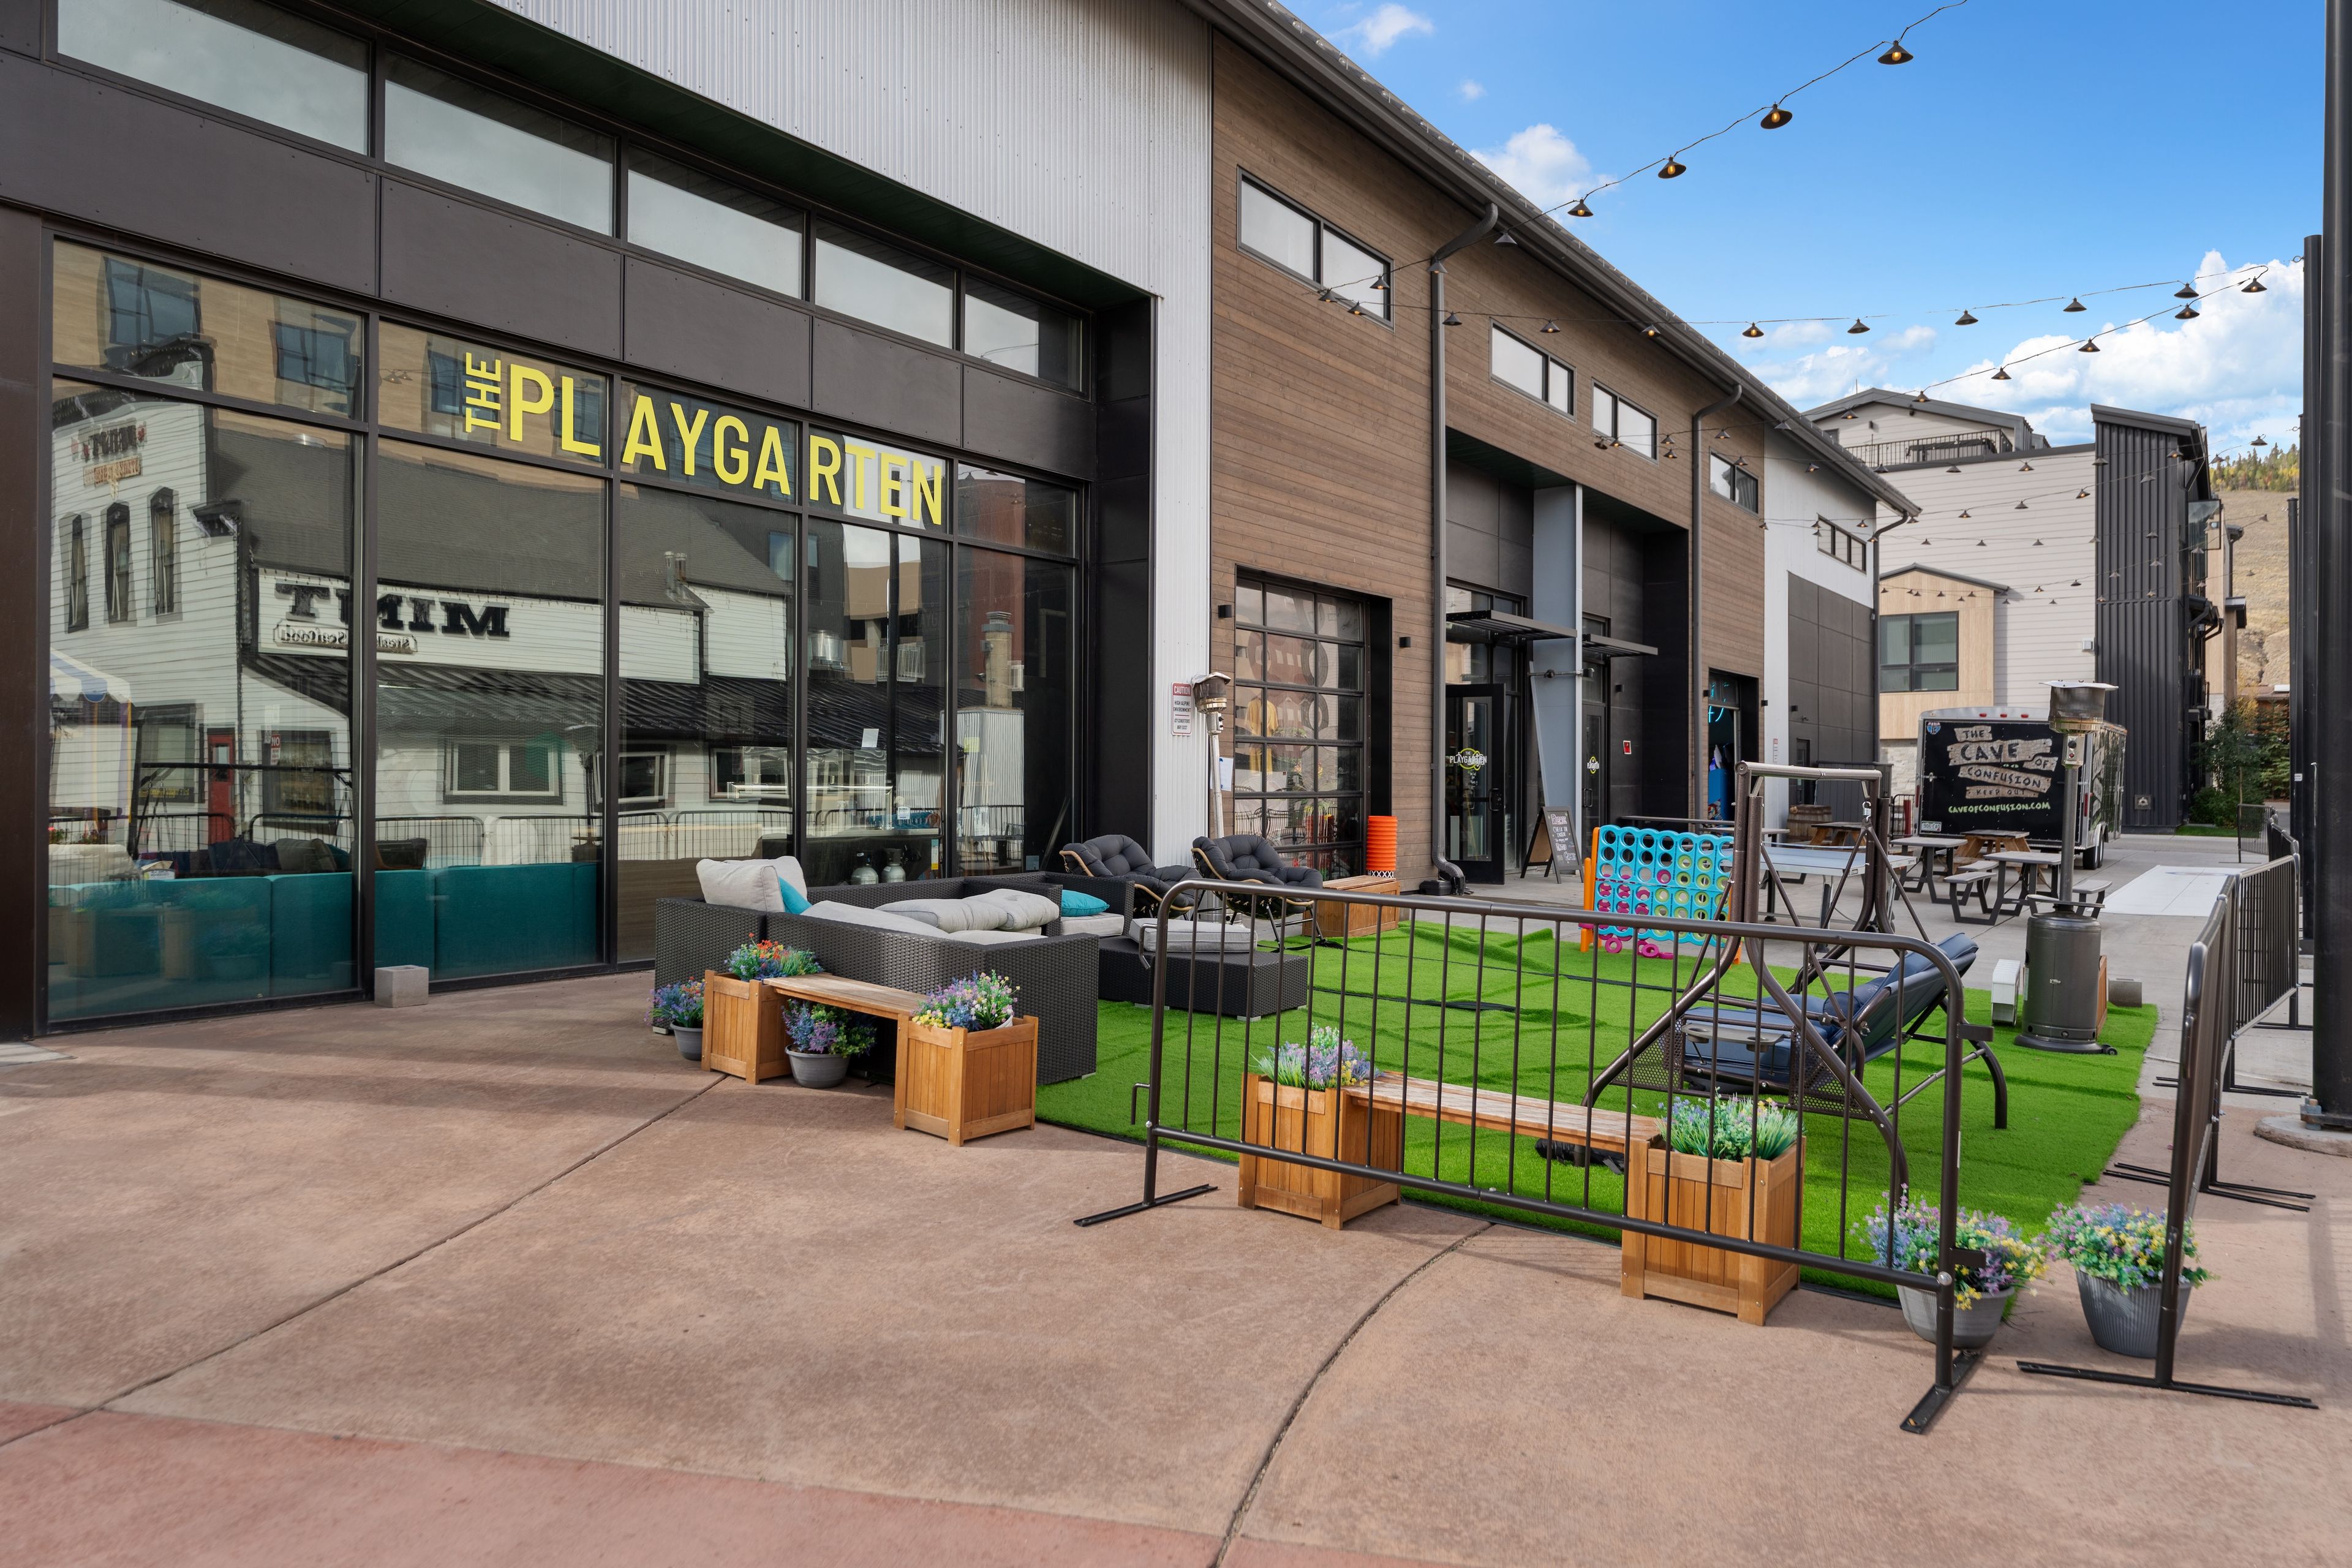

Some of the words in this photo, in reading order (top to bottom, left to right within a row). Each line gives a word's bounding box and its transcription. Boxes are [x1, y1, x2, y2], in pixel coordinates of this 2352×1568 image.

[466, 352, 501, 433] THE
[510, 363, 942, 526] PLAYGARTEN
[1174, 685, 1191, 695] CAUTION
[1962, 729, 1985, 739] THE
[1961, 743, 2019, 761] CAVE
[2035, 758, 2049, 769] OF
[1967, 766, 2041, 788] CONFUSION
[1948, 801, 2051, 813] CAVEOFCONFUSION.COM
